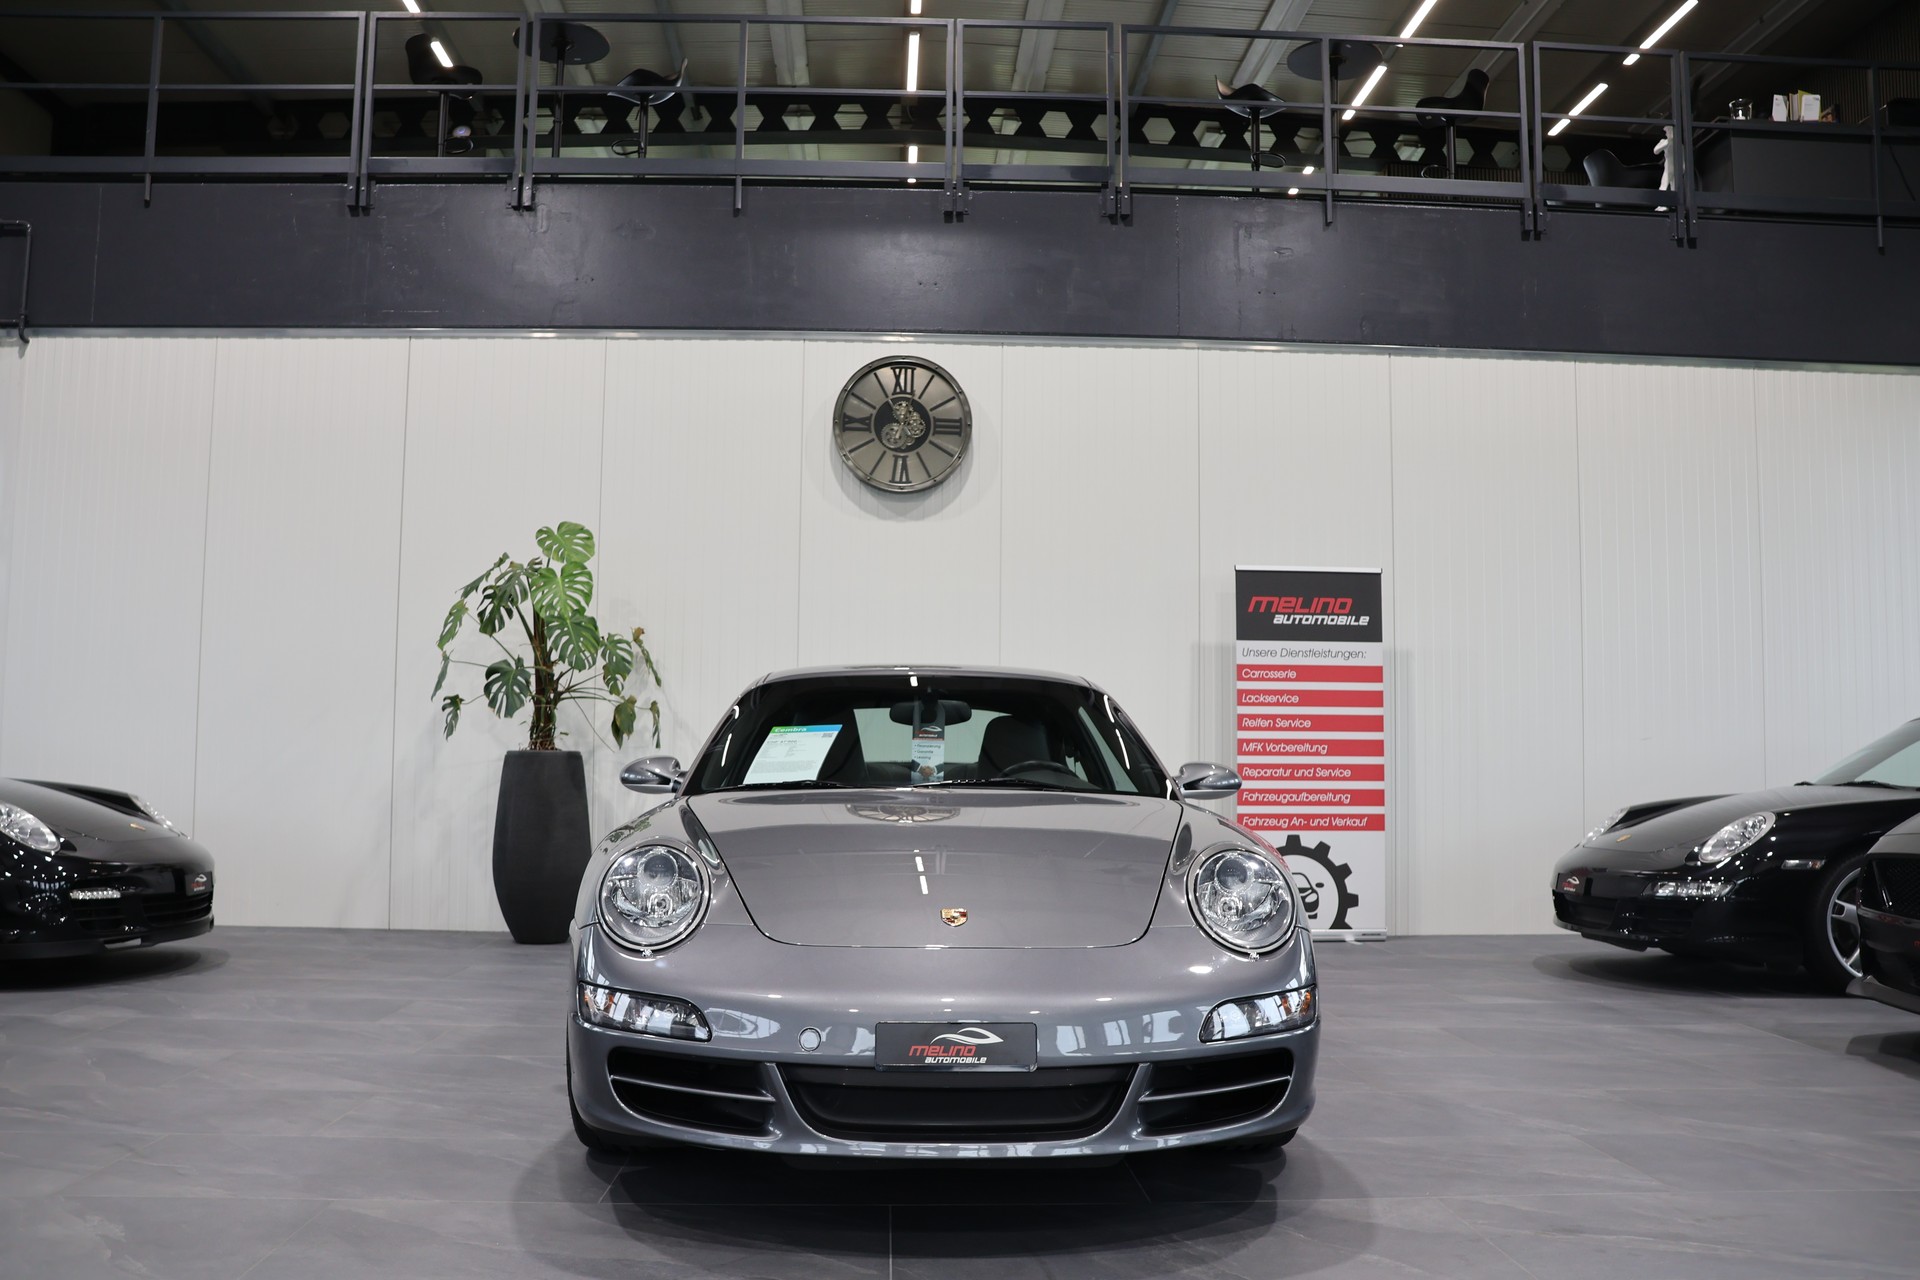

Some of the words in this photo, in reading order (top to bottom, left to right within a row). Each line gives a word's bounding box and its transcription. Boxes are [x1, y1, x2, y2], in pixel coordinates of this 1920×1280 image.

[1242, 648, 1278, 658] Unsere
[1280, 648, 1367, 661] Dienstleistungen:
[1242, 668, 1297, 679] Carrosserie
[1242, 693, 1299, 703] Lackservice
[1242, 717, 1273, 728] Reifen
[1275, 718, 1312, 728] Service
[1242, 742, 1264, 752] MFK
[1266, 742, 1328, 755] Vorbereitung
[1242, 767, 1292, 779] Reparatur
[1294, 767, 1314, 777] und
[1315, 767, 1352, 777] Service
[1242, 792, 1351, 804] Fahrzeugaufbereitung
[1242, 816, 1289, 828] Fahrzeug
[1290, 816, 1308, 827] An-
[1310, 817, 1330, 827] und
[1331, 816, 1368, 827] Verkauf
